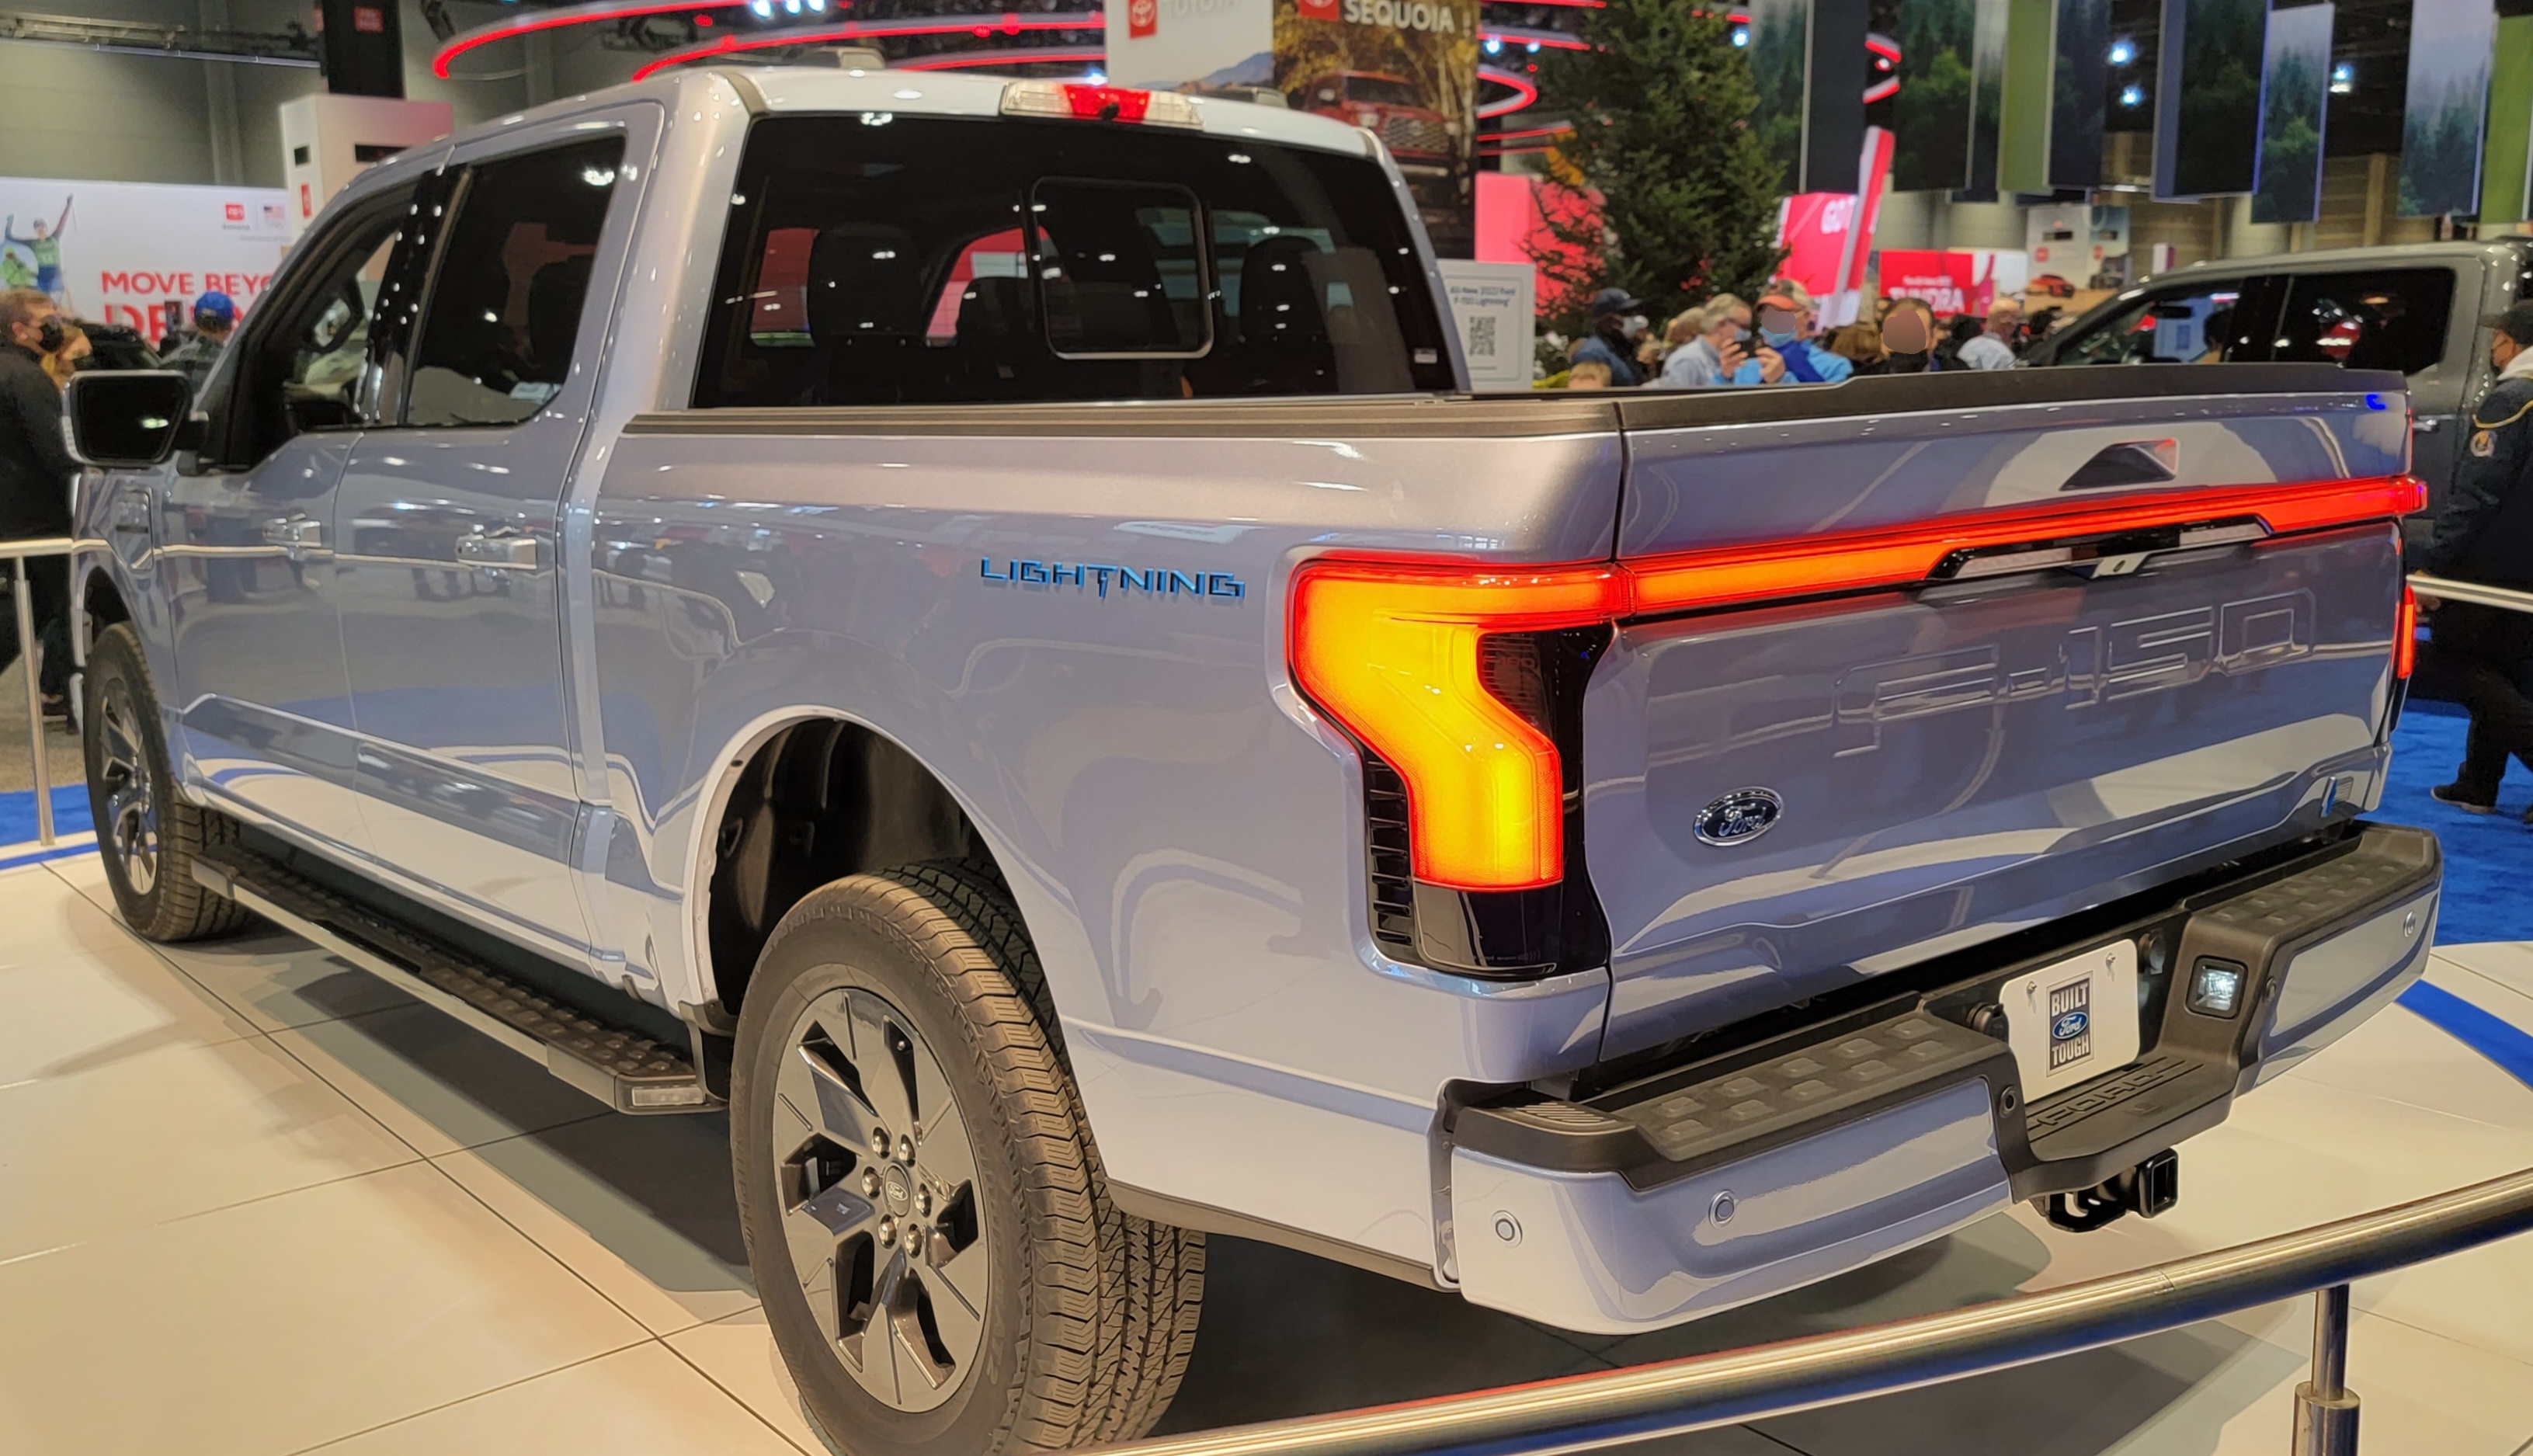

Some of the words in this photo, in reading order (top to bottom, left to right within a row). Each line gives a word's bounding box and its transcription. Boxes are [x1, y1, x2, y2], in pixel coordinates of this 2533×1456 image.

[1343, 0, 1455, 33] SEQUOIA
[101, 271, 195, 294] MOVE
[981, 556, 1246, 599] LIGHTNING
[1833, 587, 2316, 758] F-150
[2052, 983, 2089, 1017] BUILT
[2059, 1016, 2082, 1036] Ford
[2052, 1034, 2090, 1066] TOUGH
